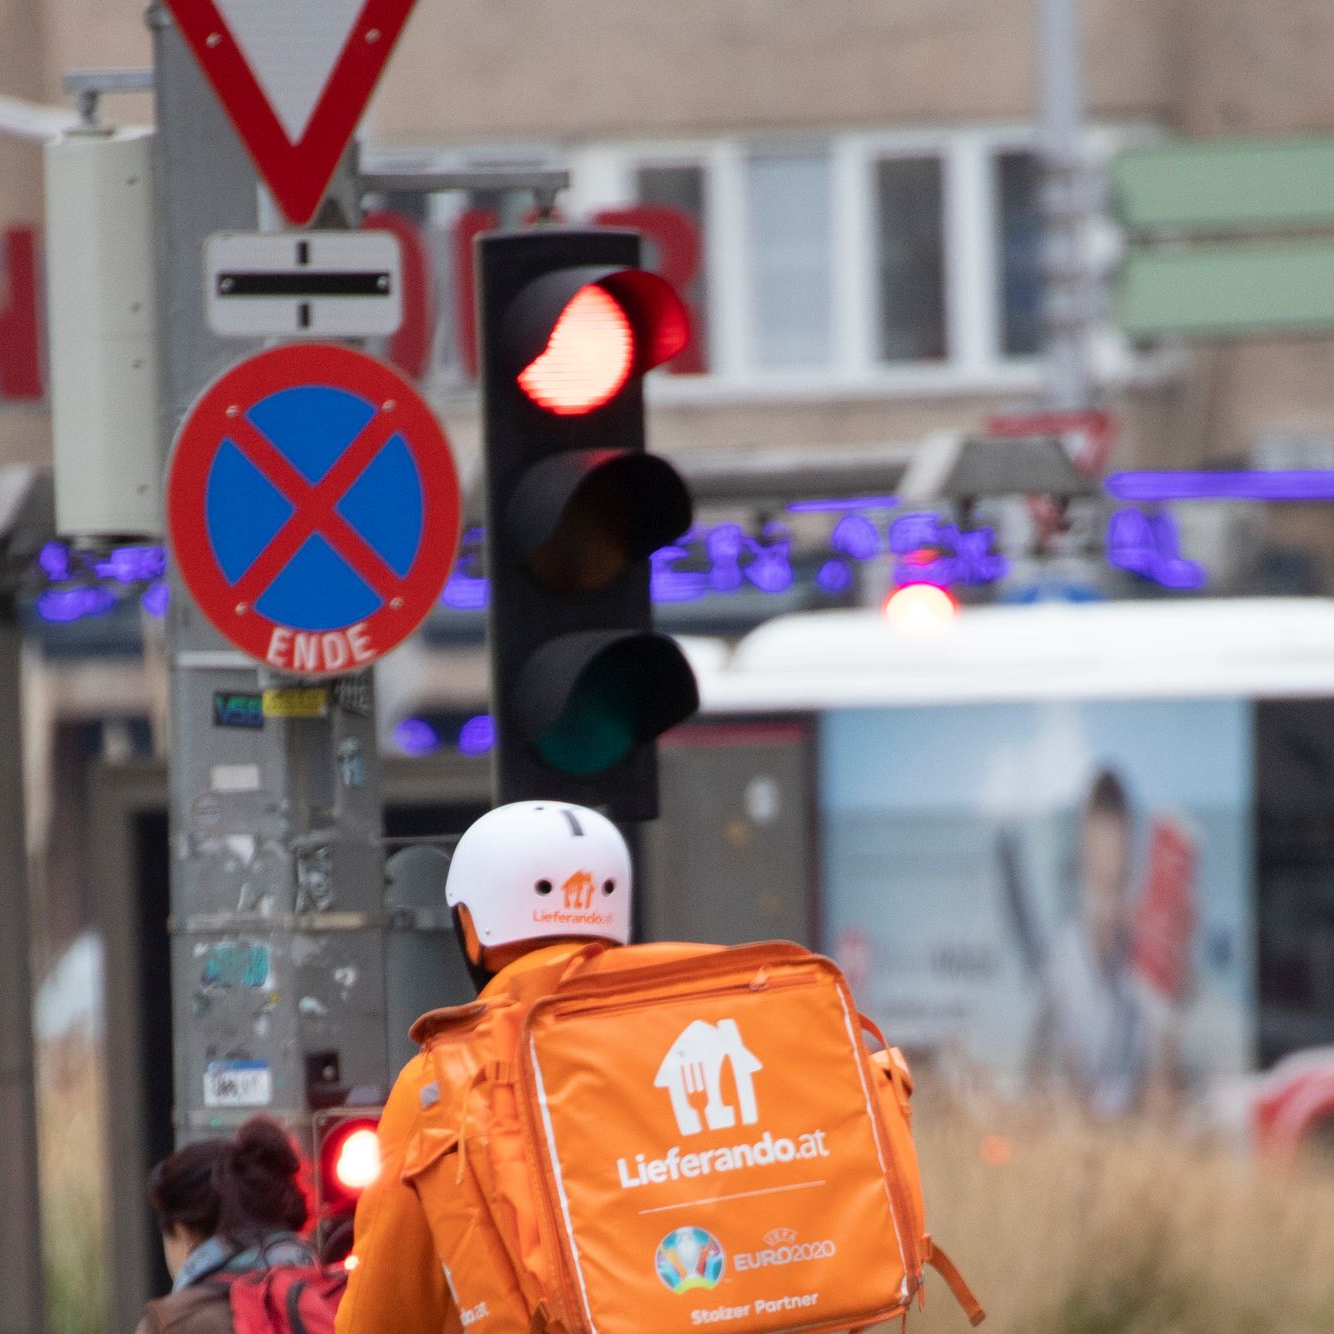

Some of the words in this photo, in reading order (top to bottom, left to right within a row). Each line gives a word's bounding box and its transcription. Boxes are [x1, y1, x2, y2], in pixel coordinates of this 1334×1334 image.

[267, 622, 378, 671] ENDE
[617, 1129, 830, 1189] Lieferando.at
[690, 1303, 752, 1325] Stolzer
[754, 1292, 819, 1315] Partner
